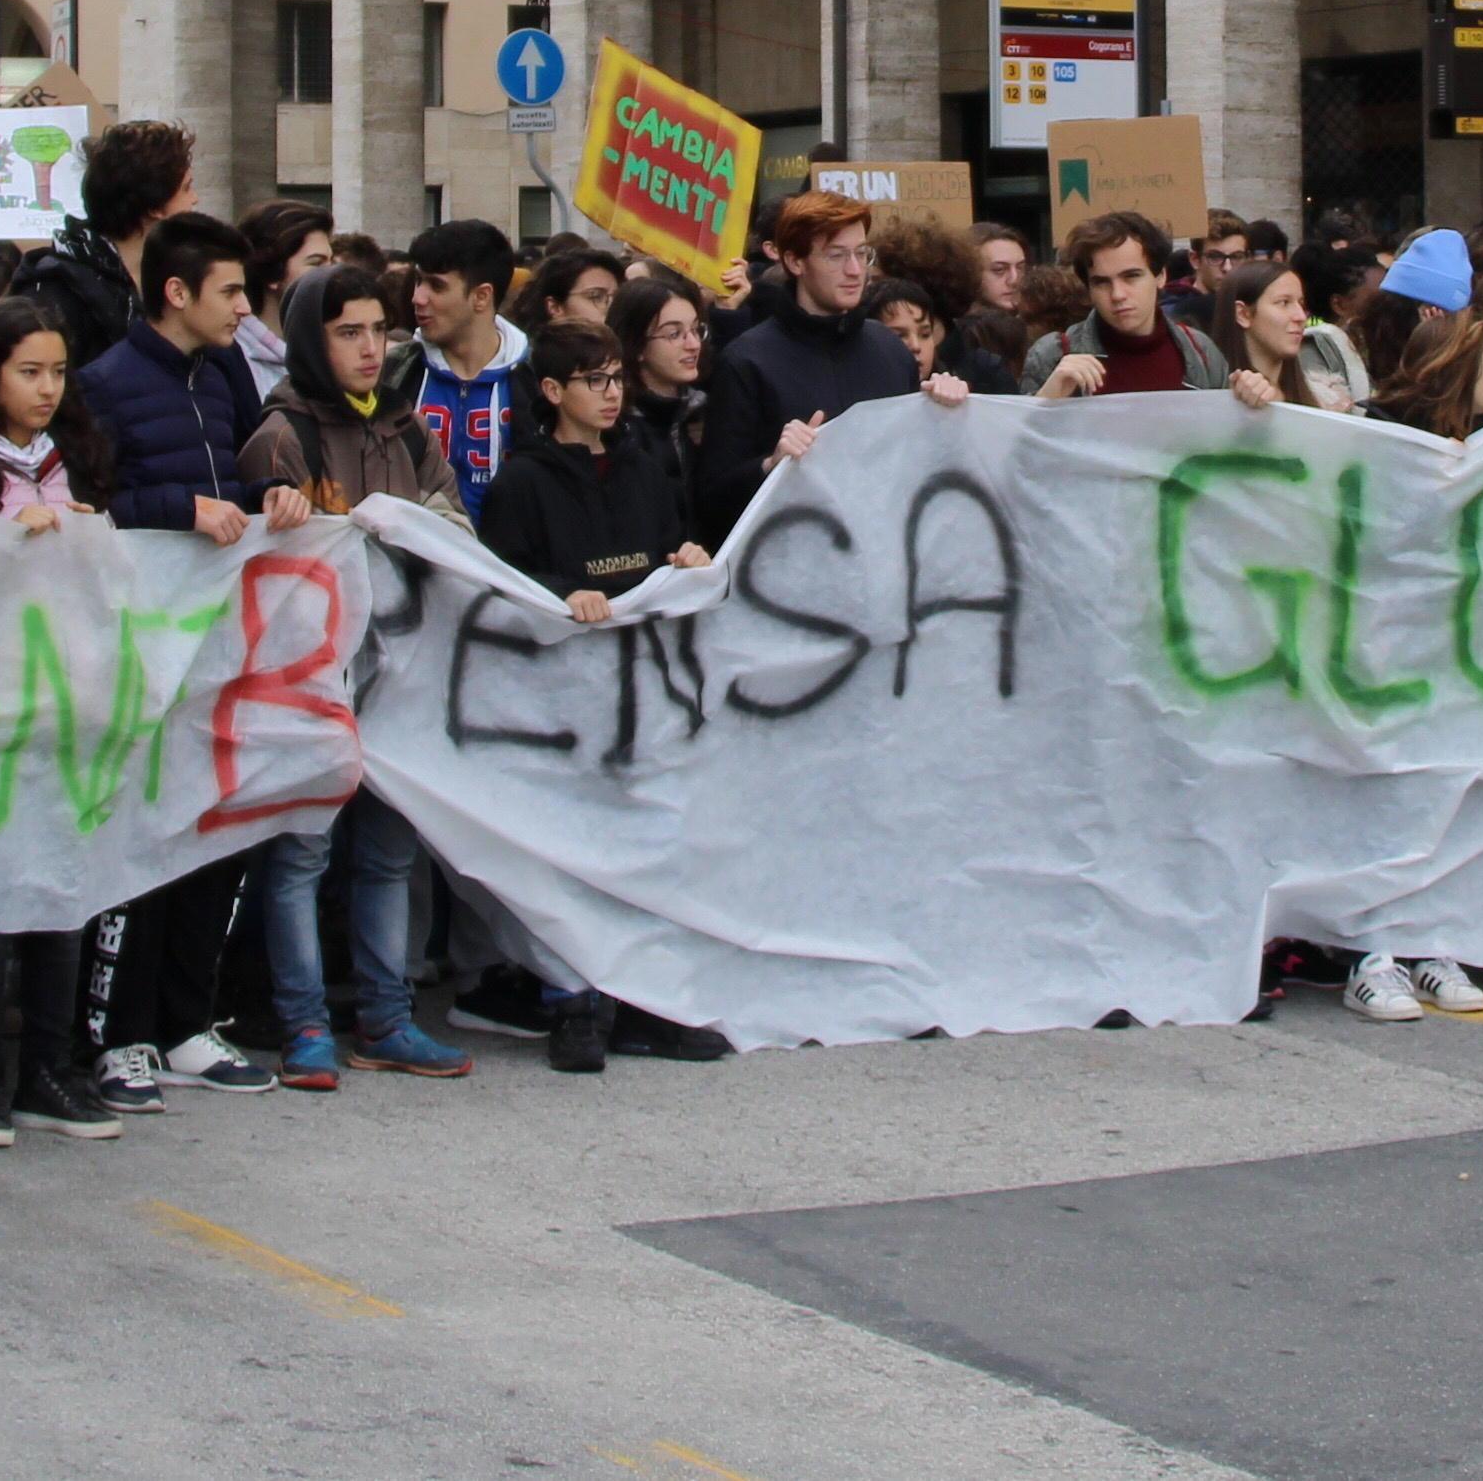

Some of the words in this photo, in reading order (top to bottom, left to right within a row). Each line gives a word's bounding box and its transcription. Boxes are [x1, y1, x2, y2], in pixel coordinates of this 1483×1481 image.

[1008, 65, 1016, 77] 3
[1031, 66, 1045, 77] 10
[1055, 66, 1075, 79] 105
[1006, 88, 1019, 99] 12
[614, 96, 736, 190] CAMBIA
[819, 171, 859, 200] PER
[862, 171, 897, 201] UN
